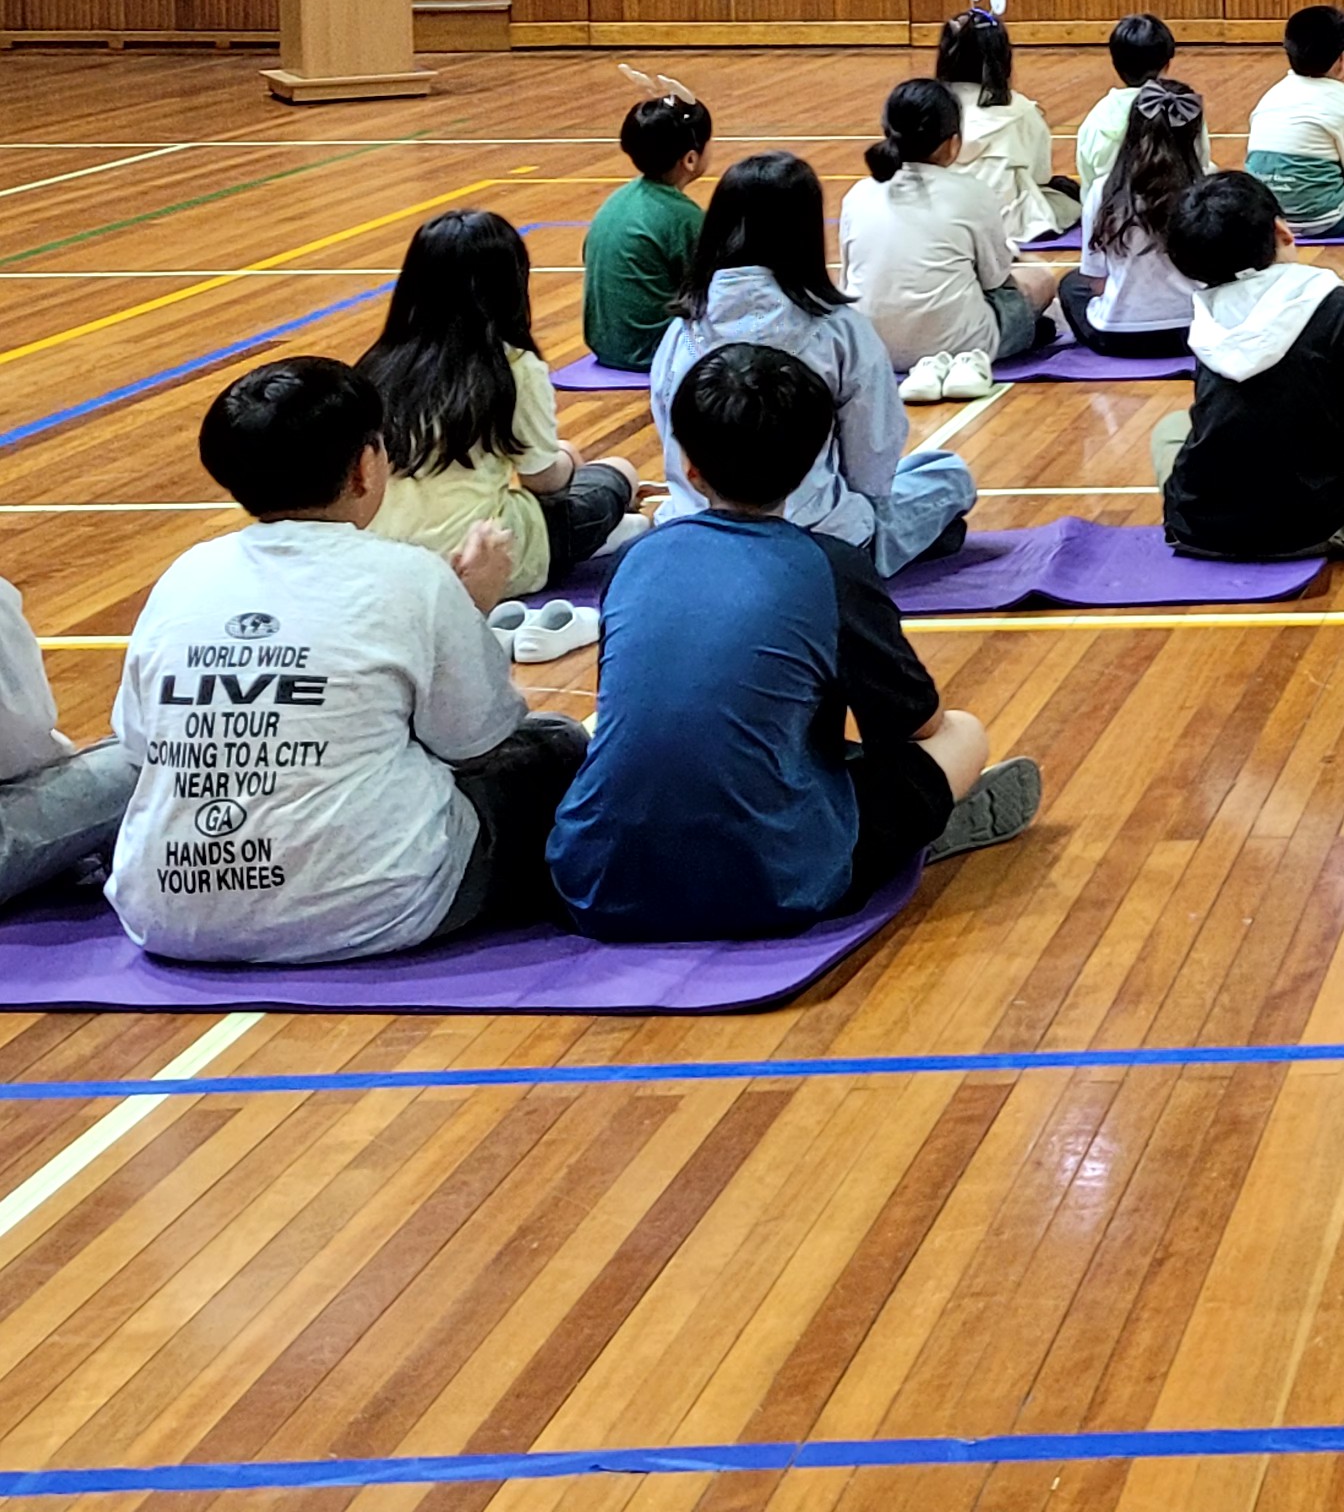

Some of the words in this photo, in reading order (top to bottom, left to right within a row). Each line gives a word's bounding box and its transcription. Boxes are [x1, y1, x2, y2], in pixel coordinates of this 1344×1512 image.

[186, 646, 251, 668] WORLD
[257, 646, 311, 668] WIDE
[158, 674, 328, 706] LIVE
[184, 711, 216, 738] ON
[221, 711, 281, 738] TOUR
[147, 741, 218, 768] COMING
[224, 742, 251, 768] TO
[255, 742, 269, 767] A
[275, 741, 330, 768] CITY
[173, 772, 229, 798] NEAR
[235, 771, 277, 797] YOU
[205, 805, 234, 831] GA
[166, 840, 236, 867] HANDS
[241, 838, 272, 863] ON
[157, 869, 211, 894] YOUR
[215, 865, 286, 891] KNEES
